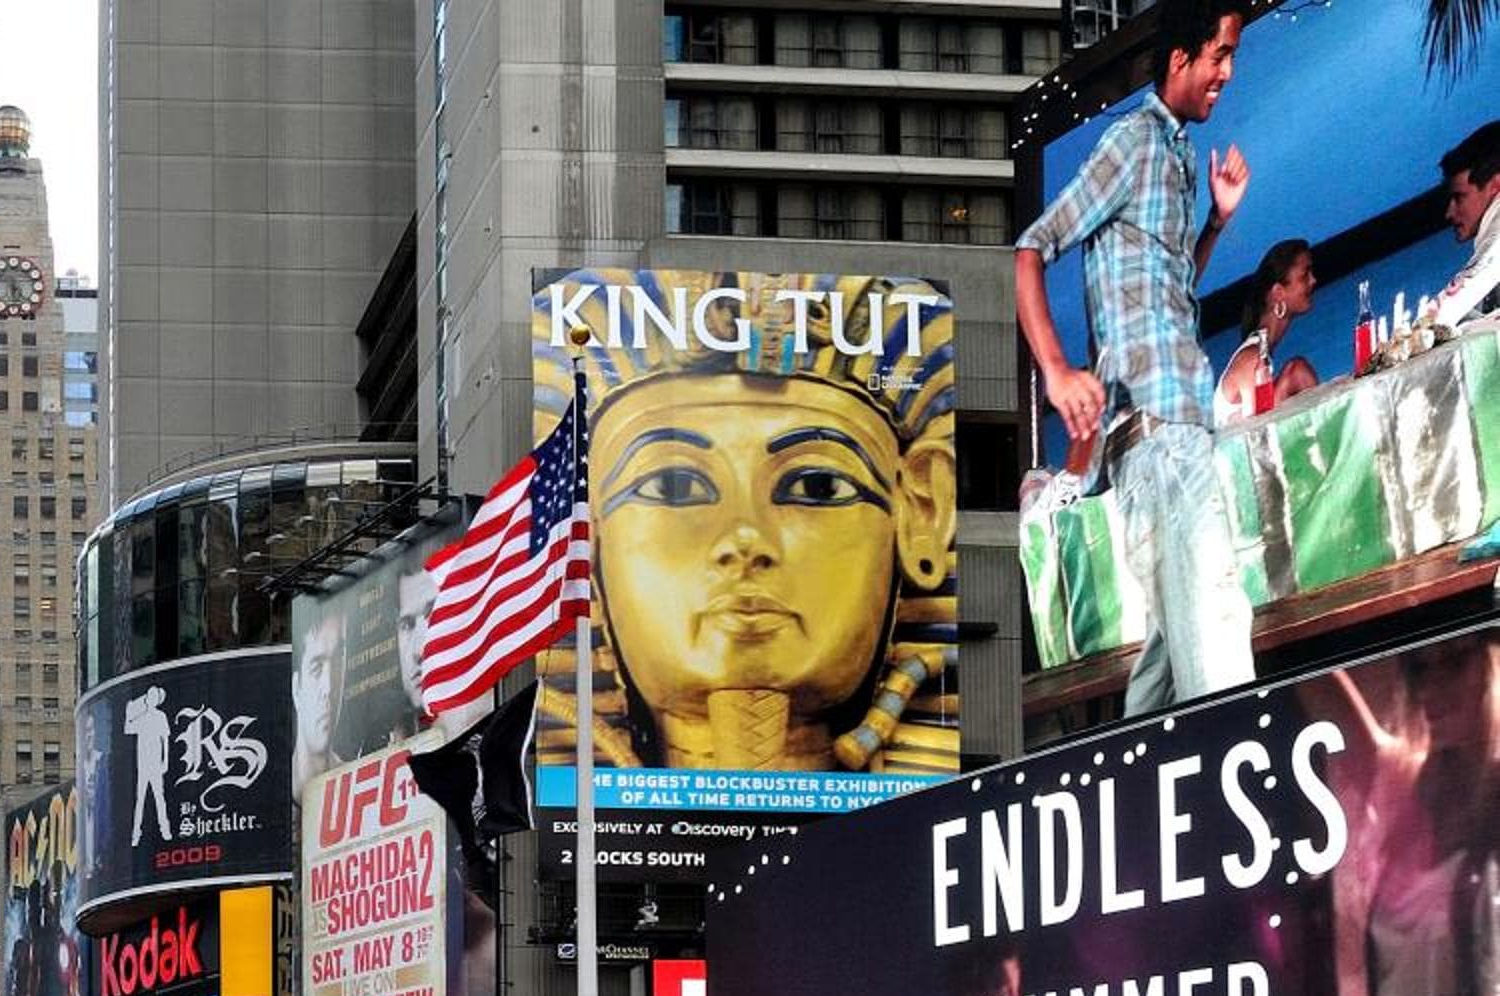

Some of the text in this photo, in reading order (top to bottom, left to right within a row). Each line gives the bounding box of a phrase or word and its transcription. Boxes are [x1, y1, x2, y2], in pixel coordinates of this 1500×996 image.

[549, 284, 941, 357] KING TUT
[591, 774, 612, 788] HE
[617, 774, 691, 790] BIGGEST
[696, 776, 820, 792] BLOCKBUSTER
[320, 749, 413, 849] UFC
[622, 791, 646, 805] OF
[651, 792, 684, 806] ALL
[688, 793, 731, 807] TIME
[735, 793, 816, 808] RETURNS
[821, 795, 843, 809] TO
[179, 812, 257, 838] Sheckler
[645, 823, 664, 835] AT
[930, 719, 1348, 948] ENDLESS
[155, 843, 221, 868] 2009
[561, 850, 707, 867] 2 OCKS SOUTH
[311, 829, 434, 911] MACHIDA 2
[327, 873, 419, 934] SHOGUN
[312, 949, 347, 984] SAT.
[354, 935, 395, 974] MAY
[401, 931, 414, 962] 8
[374, 971, 394, 993] ON
